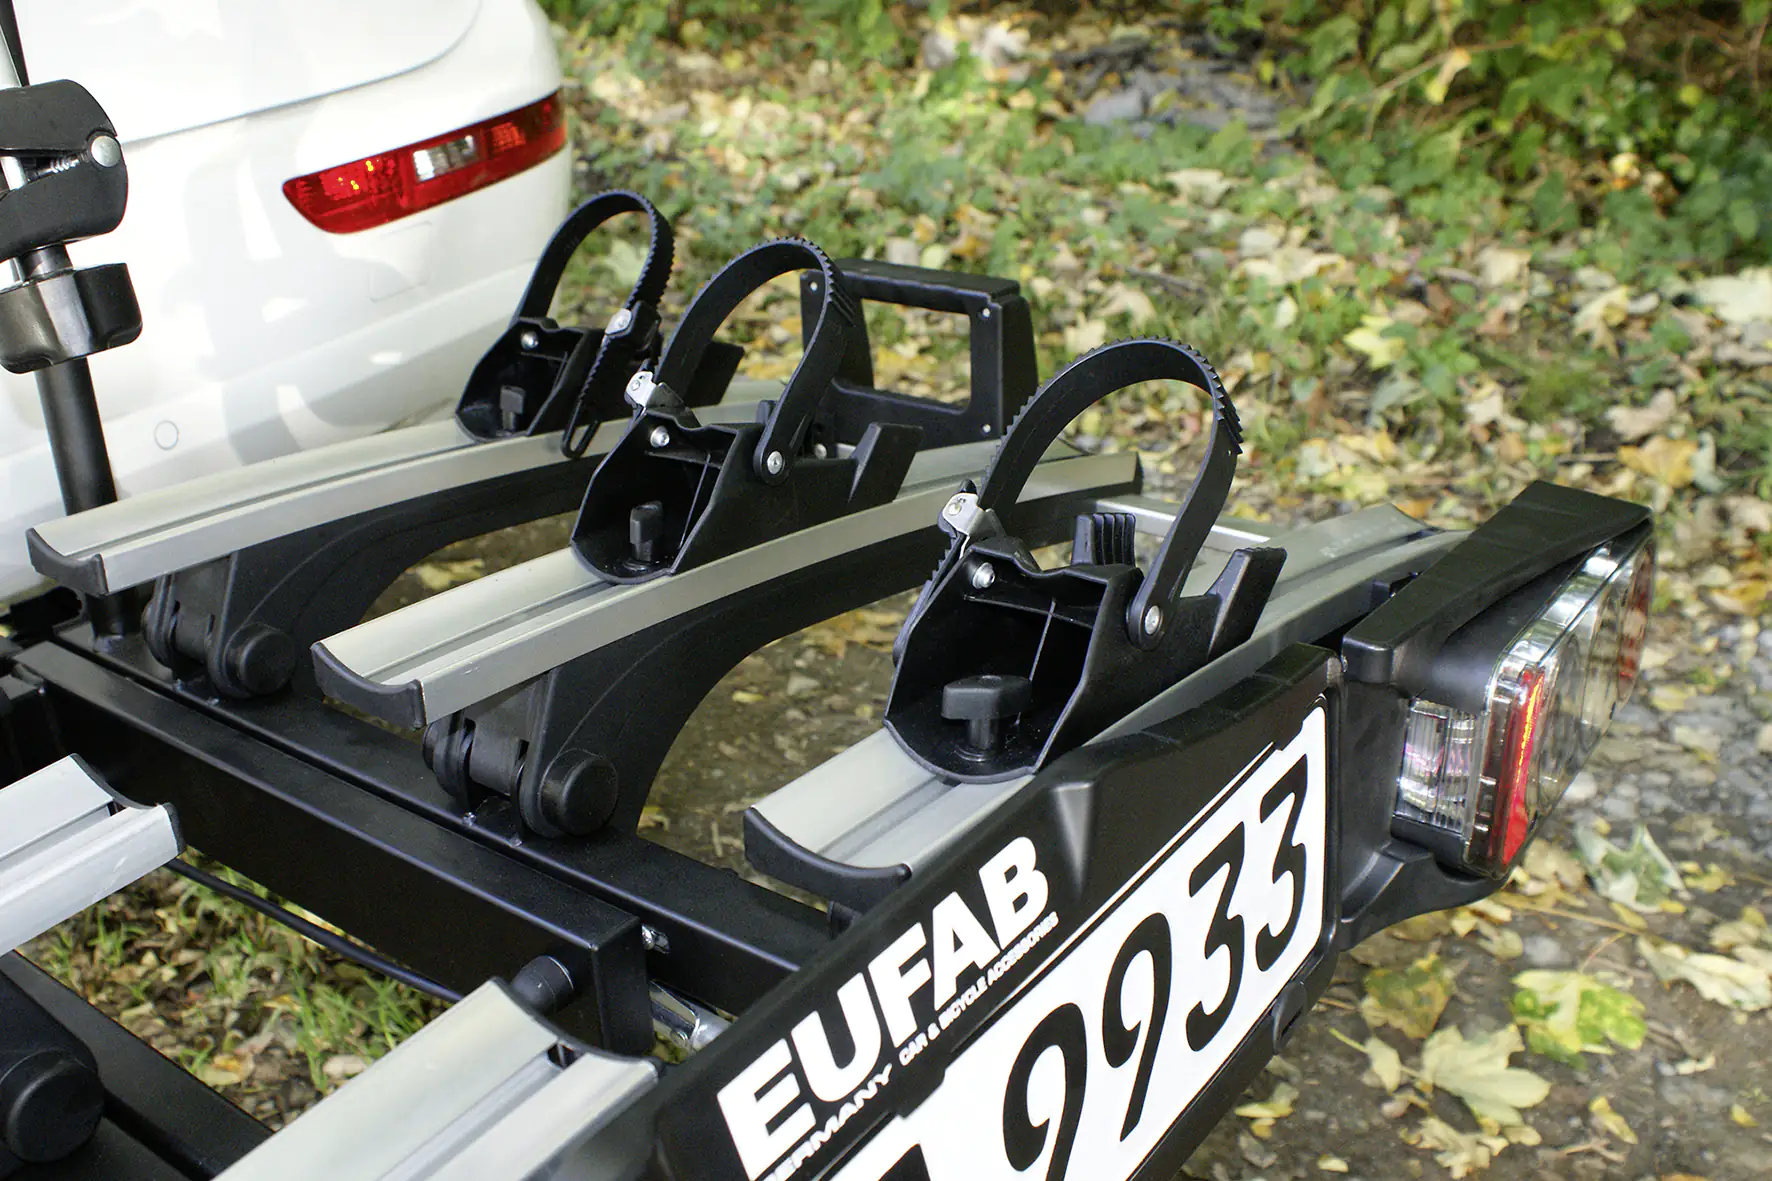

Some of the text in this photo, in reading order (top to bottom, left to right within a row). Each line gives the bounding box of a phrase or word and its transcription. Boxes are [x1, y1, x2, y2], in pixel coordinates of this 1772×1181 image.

[717, 836, 1049, 1181] EUFAB
[898, 1032, 929, 1067] CAR
[927, 1022, 941, 1041] &
[938, 975, 988, 1031] BICYCLE
[987, 911, 1060, 986] ACCESSORIES
